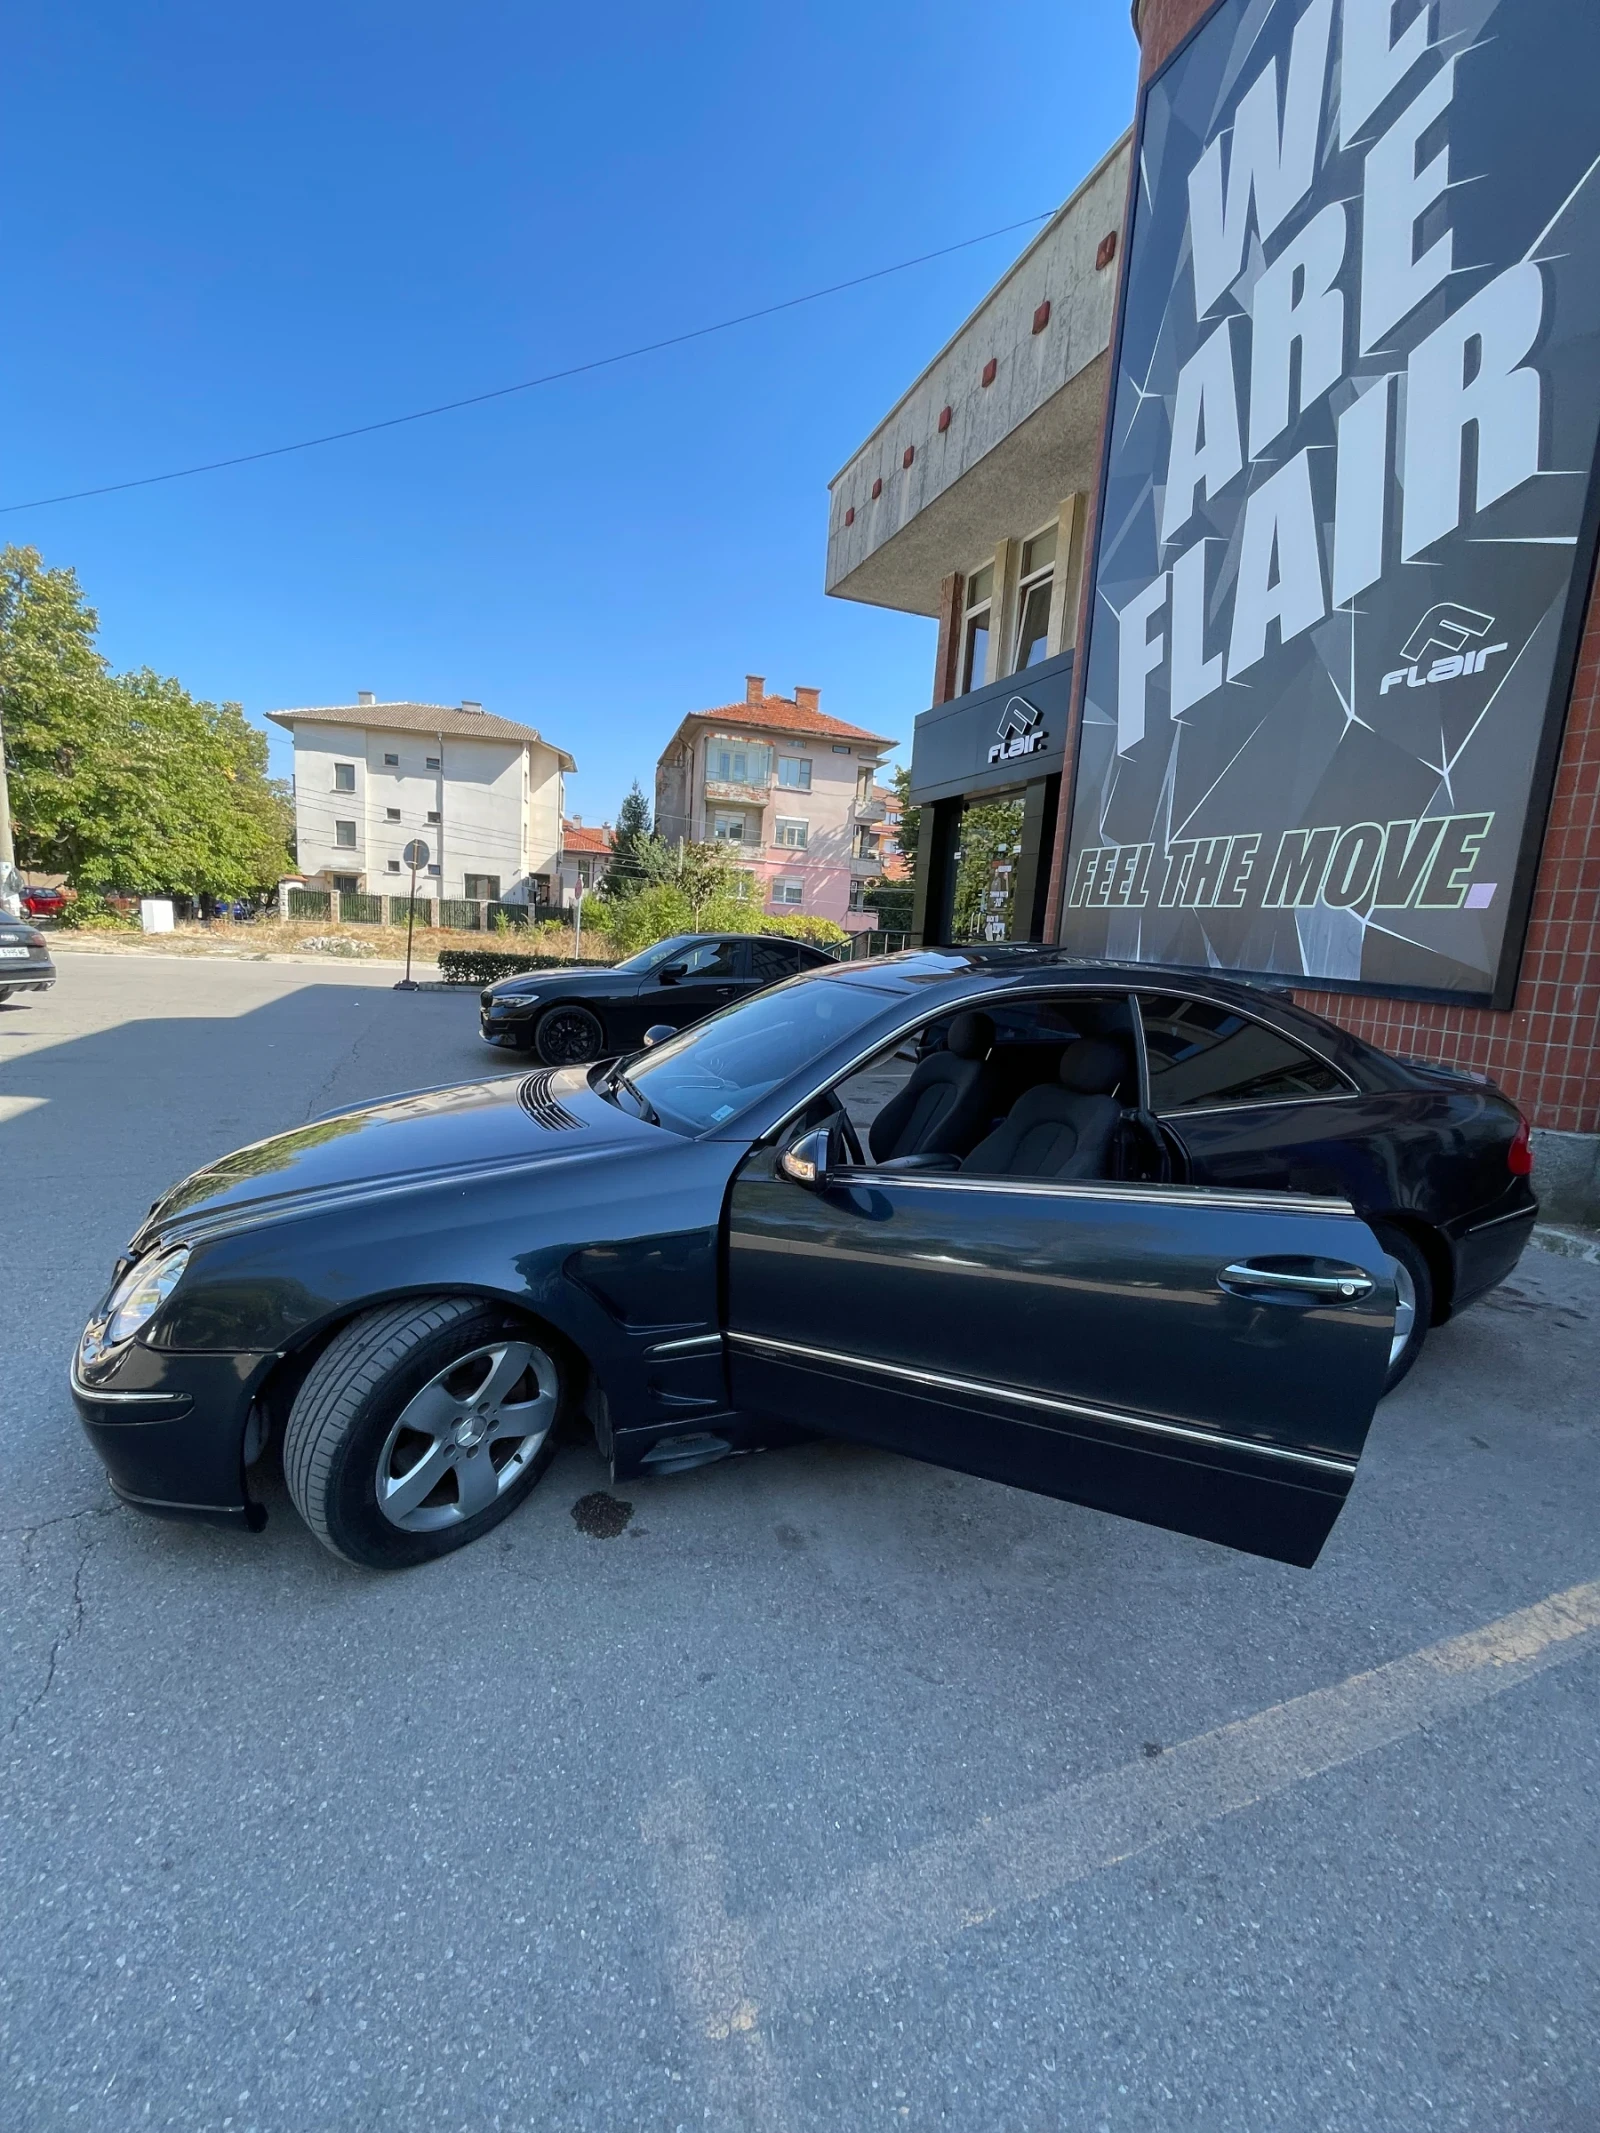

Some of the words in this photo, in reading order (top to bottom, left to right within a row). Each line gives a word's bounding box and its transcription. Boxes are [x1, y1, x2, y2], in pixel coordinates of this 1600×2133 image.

[1117, 262, 1544, 757] FLAIR
[1161, 55, 1455, 544] ARE
[1069, 843, 1155, 908] FEEL
[1158, 833, 1262, 908] THE
